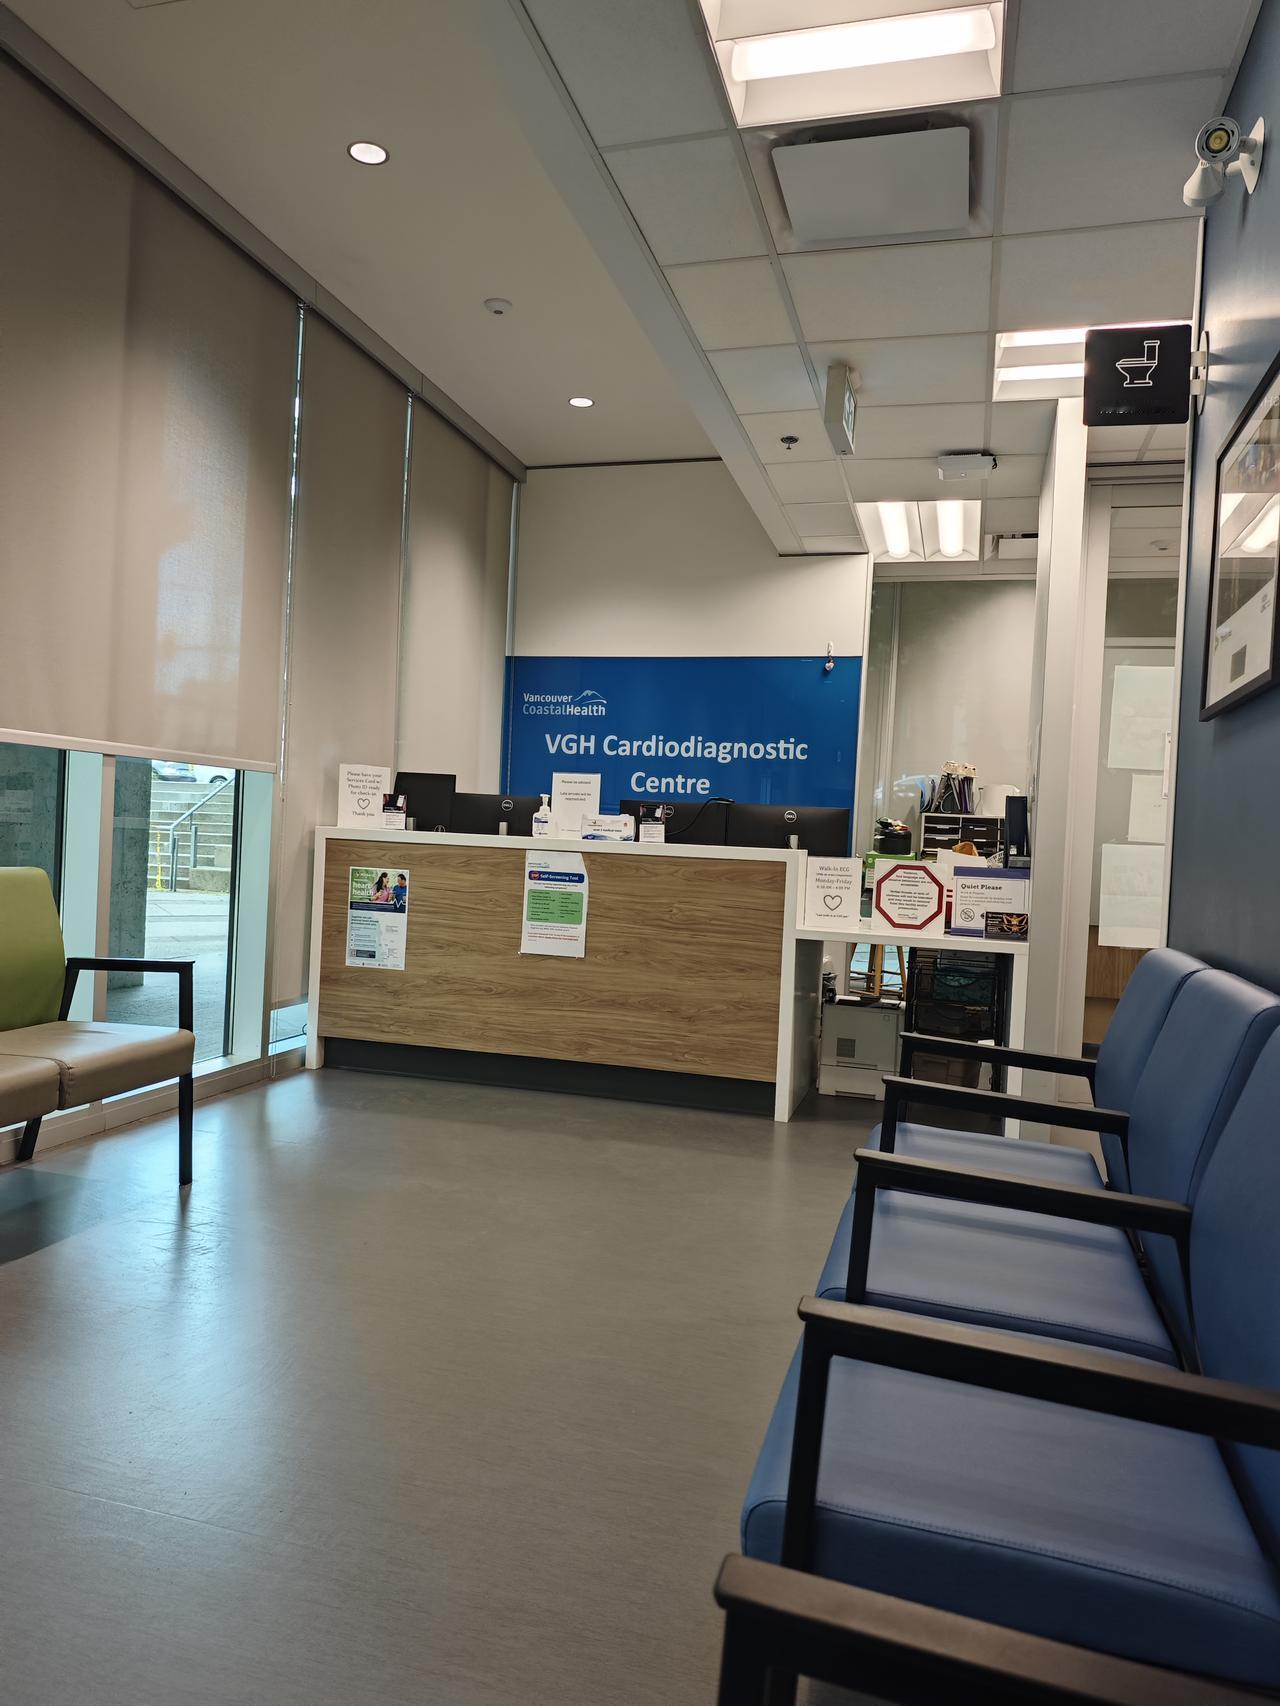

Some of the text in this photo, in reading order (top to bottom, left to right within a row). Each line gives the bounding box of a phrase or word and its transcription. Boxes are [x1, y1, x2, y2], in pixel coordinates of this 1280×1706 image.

[523, 693, 573, 703] Vancouver
[522, 704, 606, 716] CoastalHealth
[545, 733, 808, 763] VGH Cardiodiagnostic
[630, 771, 711, 794] Centre
[980, 883, 1003, 891] Please
